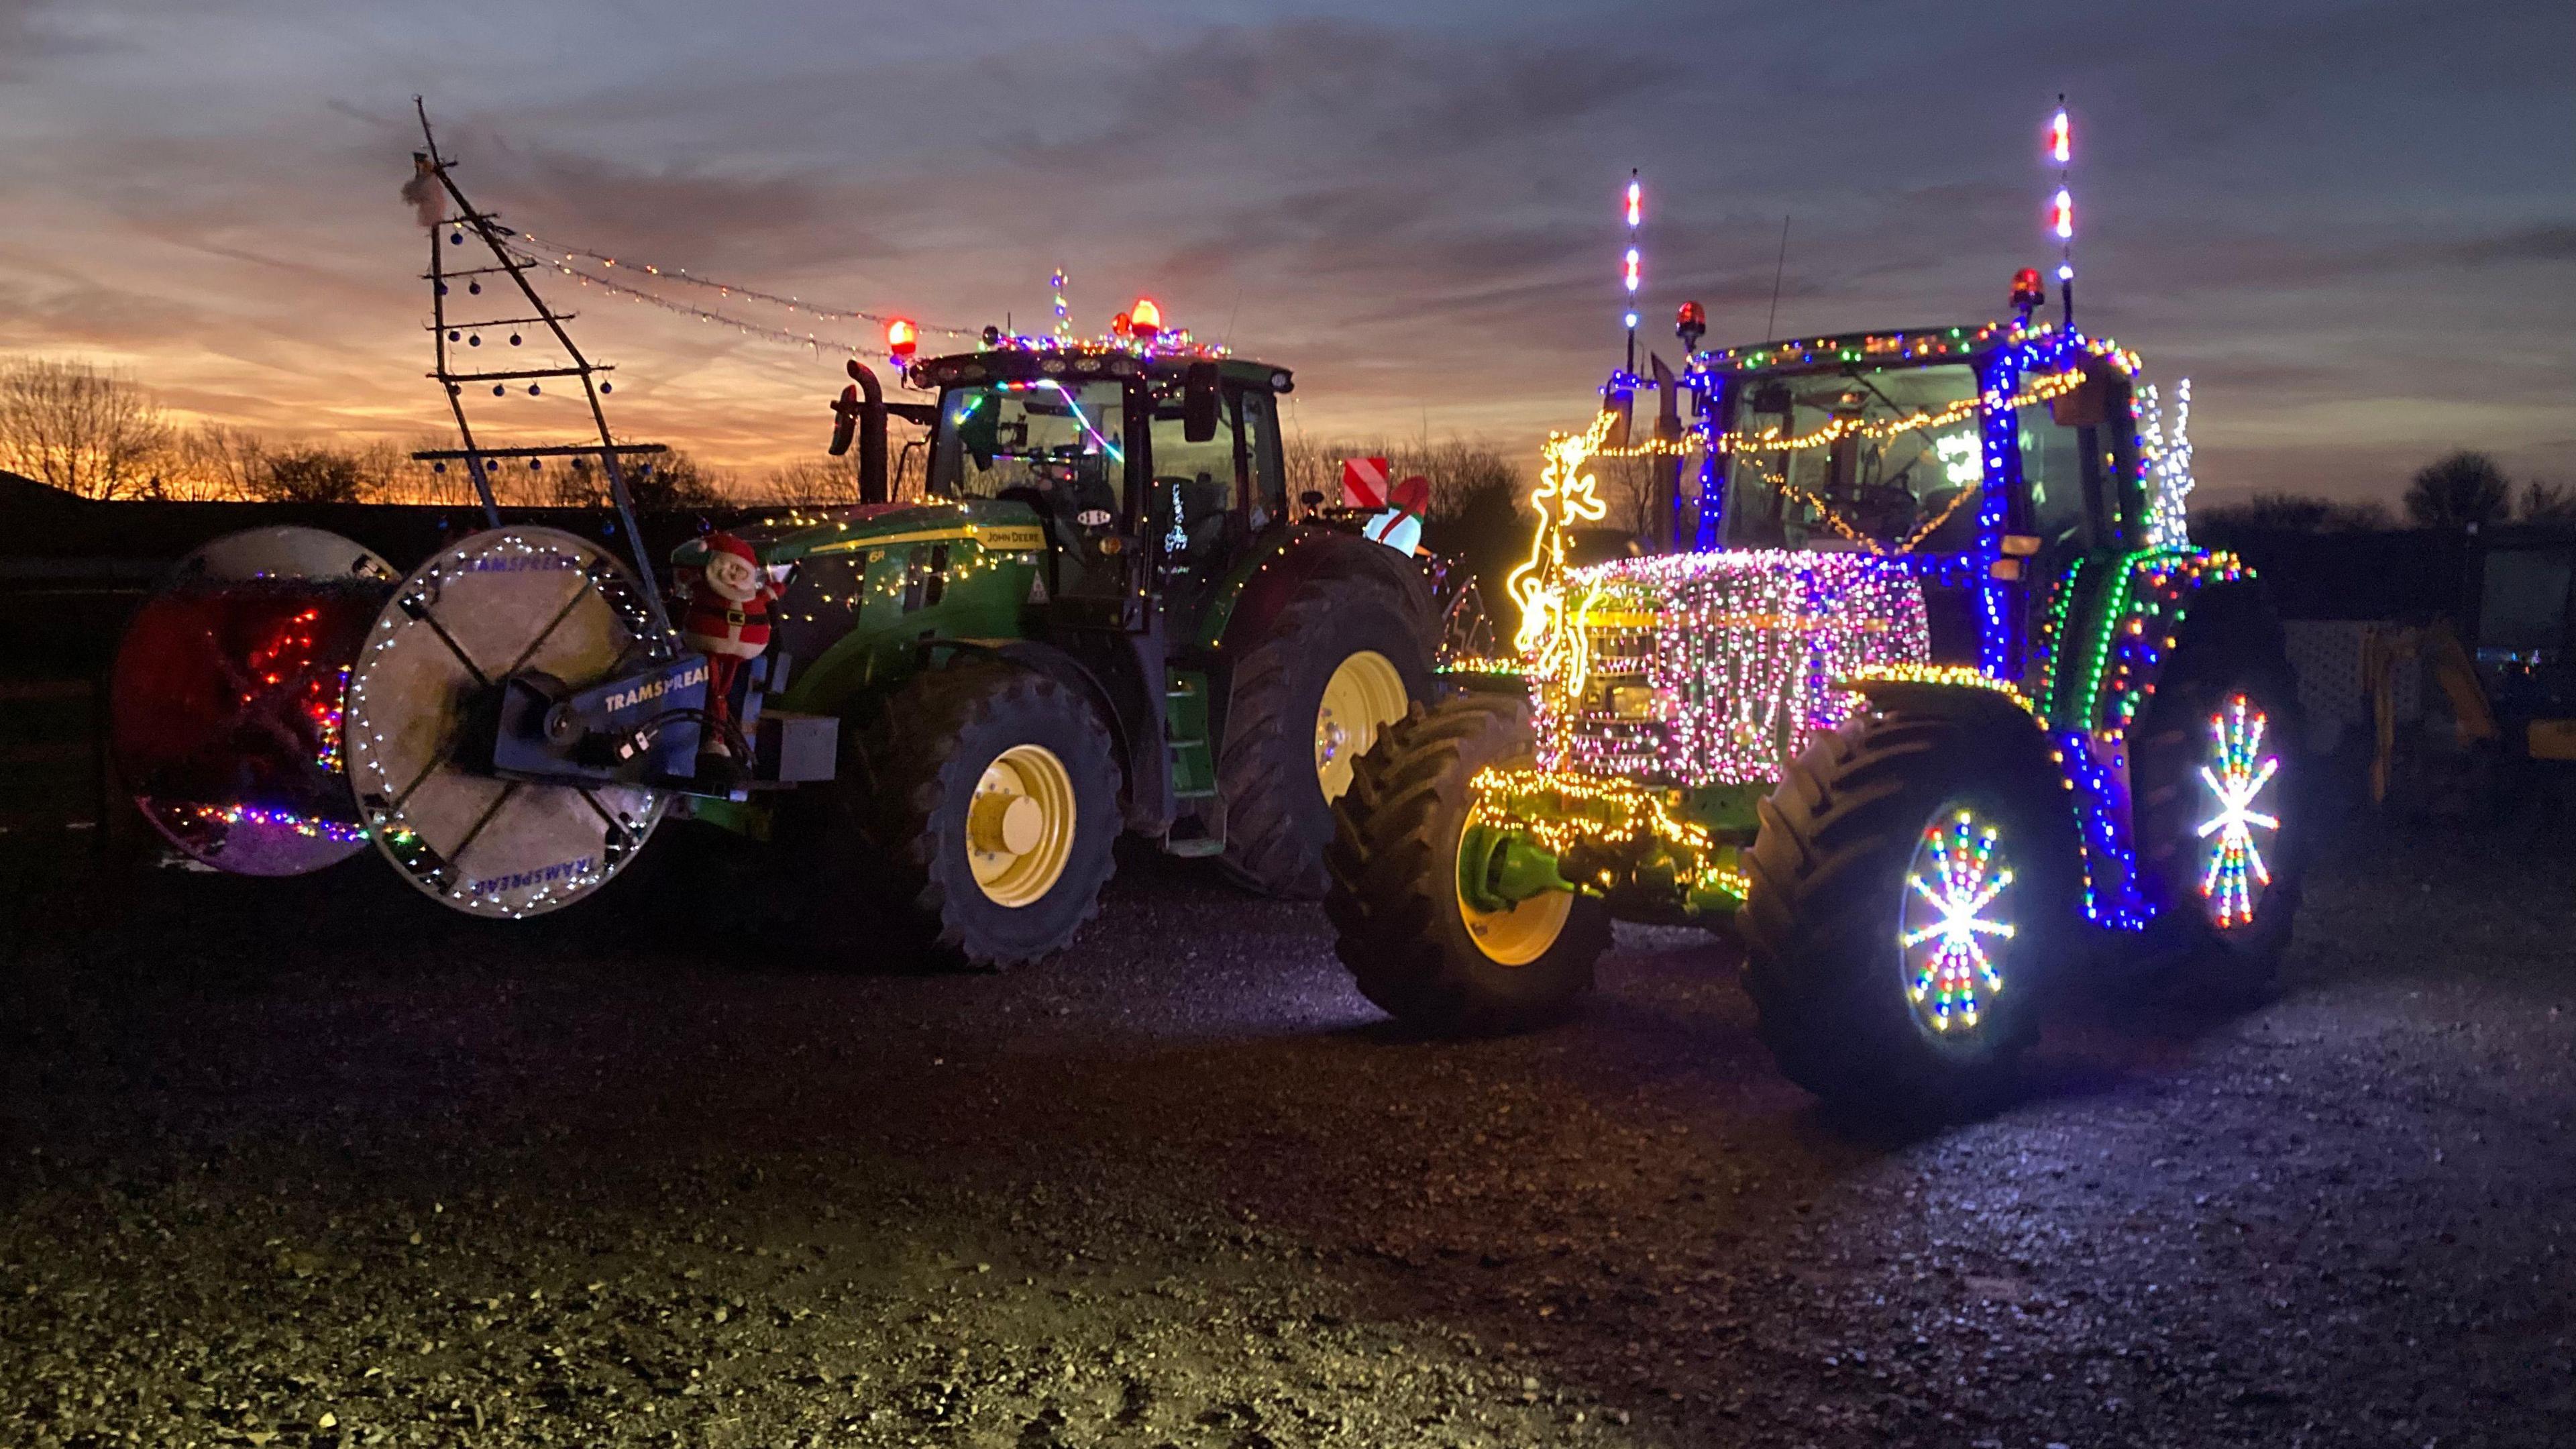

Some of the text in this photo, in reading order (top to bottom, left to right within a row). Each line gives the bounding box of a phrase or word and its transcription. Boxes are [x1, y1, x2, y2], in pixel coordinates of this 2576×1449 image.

[987, 531, 1040, 543] JOHN DEERE
[869, 549, 885, 563] 6R
[459, 556, 577, 573] RAMSPREA
[472, 857, 594, 896] TRAMSPREAD
